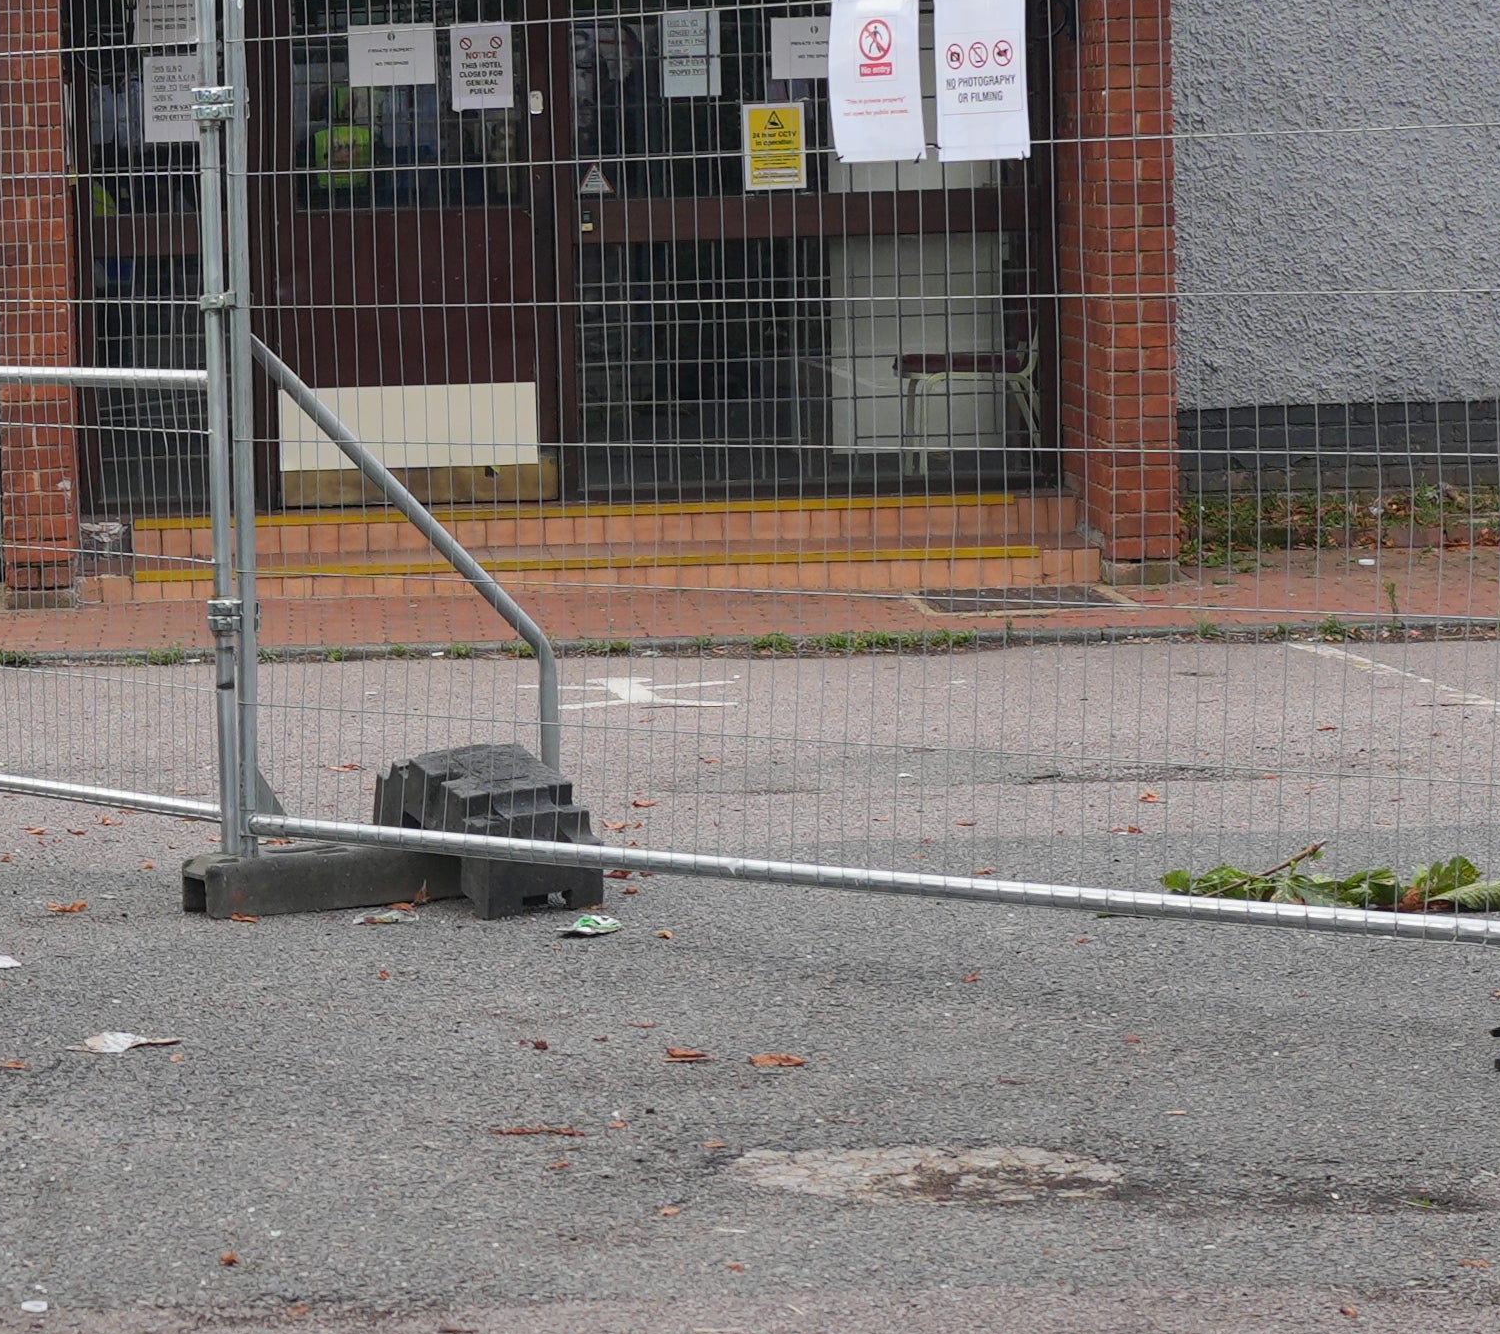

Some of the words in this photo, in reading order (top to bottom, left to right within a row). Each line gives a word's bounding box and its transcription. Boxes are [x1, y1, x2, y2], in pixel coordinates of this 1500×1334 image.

[466, 51, 498, 59] NOTICE
[872, 66, 891, 75] entry
[946, 78, 957, 89] NO
[957, 74, 1016, 87] PHOTOGRAPHY
[957, 92, 969, 102] OR
[970, 90, 1003, 101] FILMING
